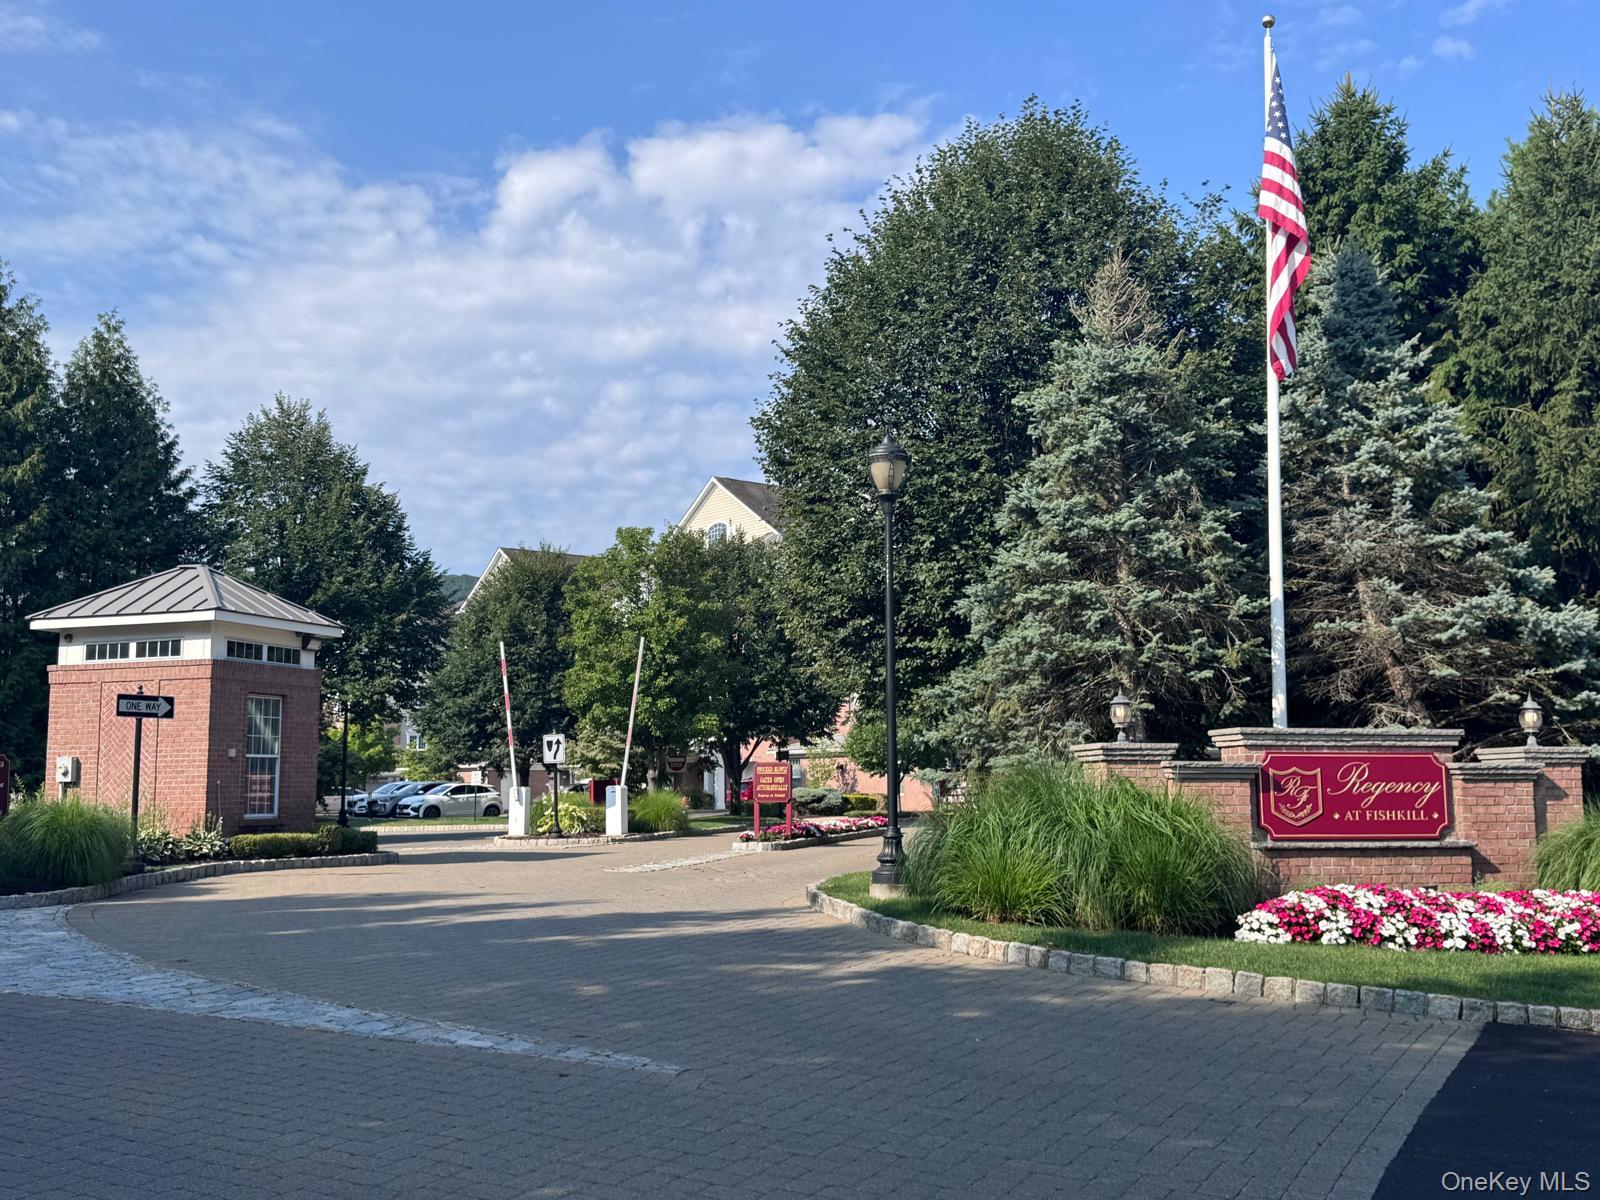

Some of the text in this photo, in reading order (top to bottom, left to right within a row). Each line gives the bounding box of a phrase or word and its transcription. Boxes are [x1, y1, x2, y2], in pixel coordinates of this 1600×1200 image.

[125, 701, 162, 712] ONE WAY
[1327, 761, 1441, 808] Regency
[1344, 809, 1429, 822] AT FISHKILL
